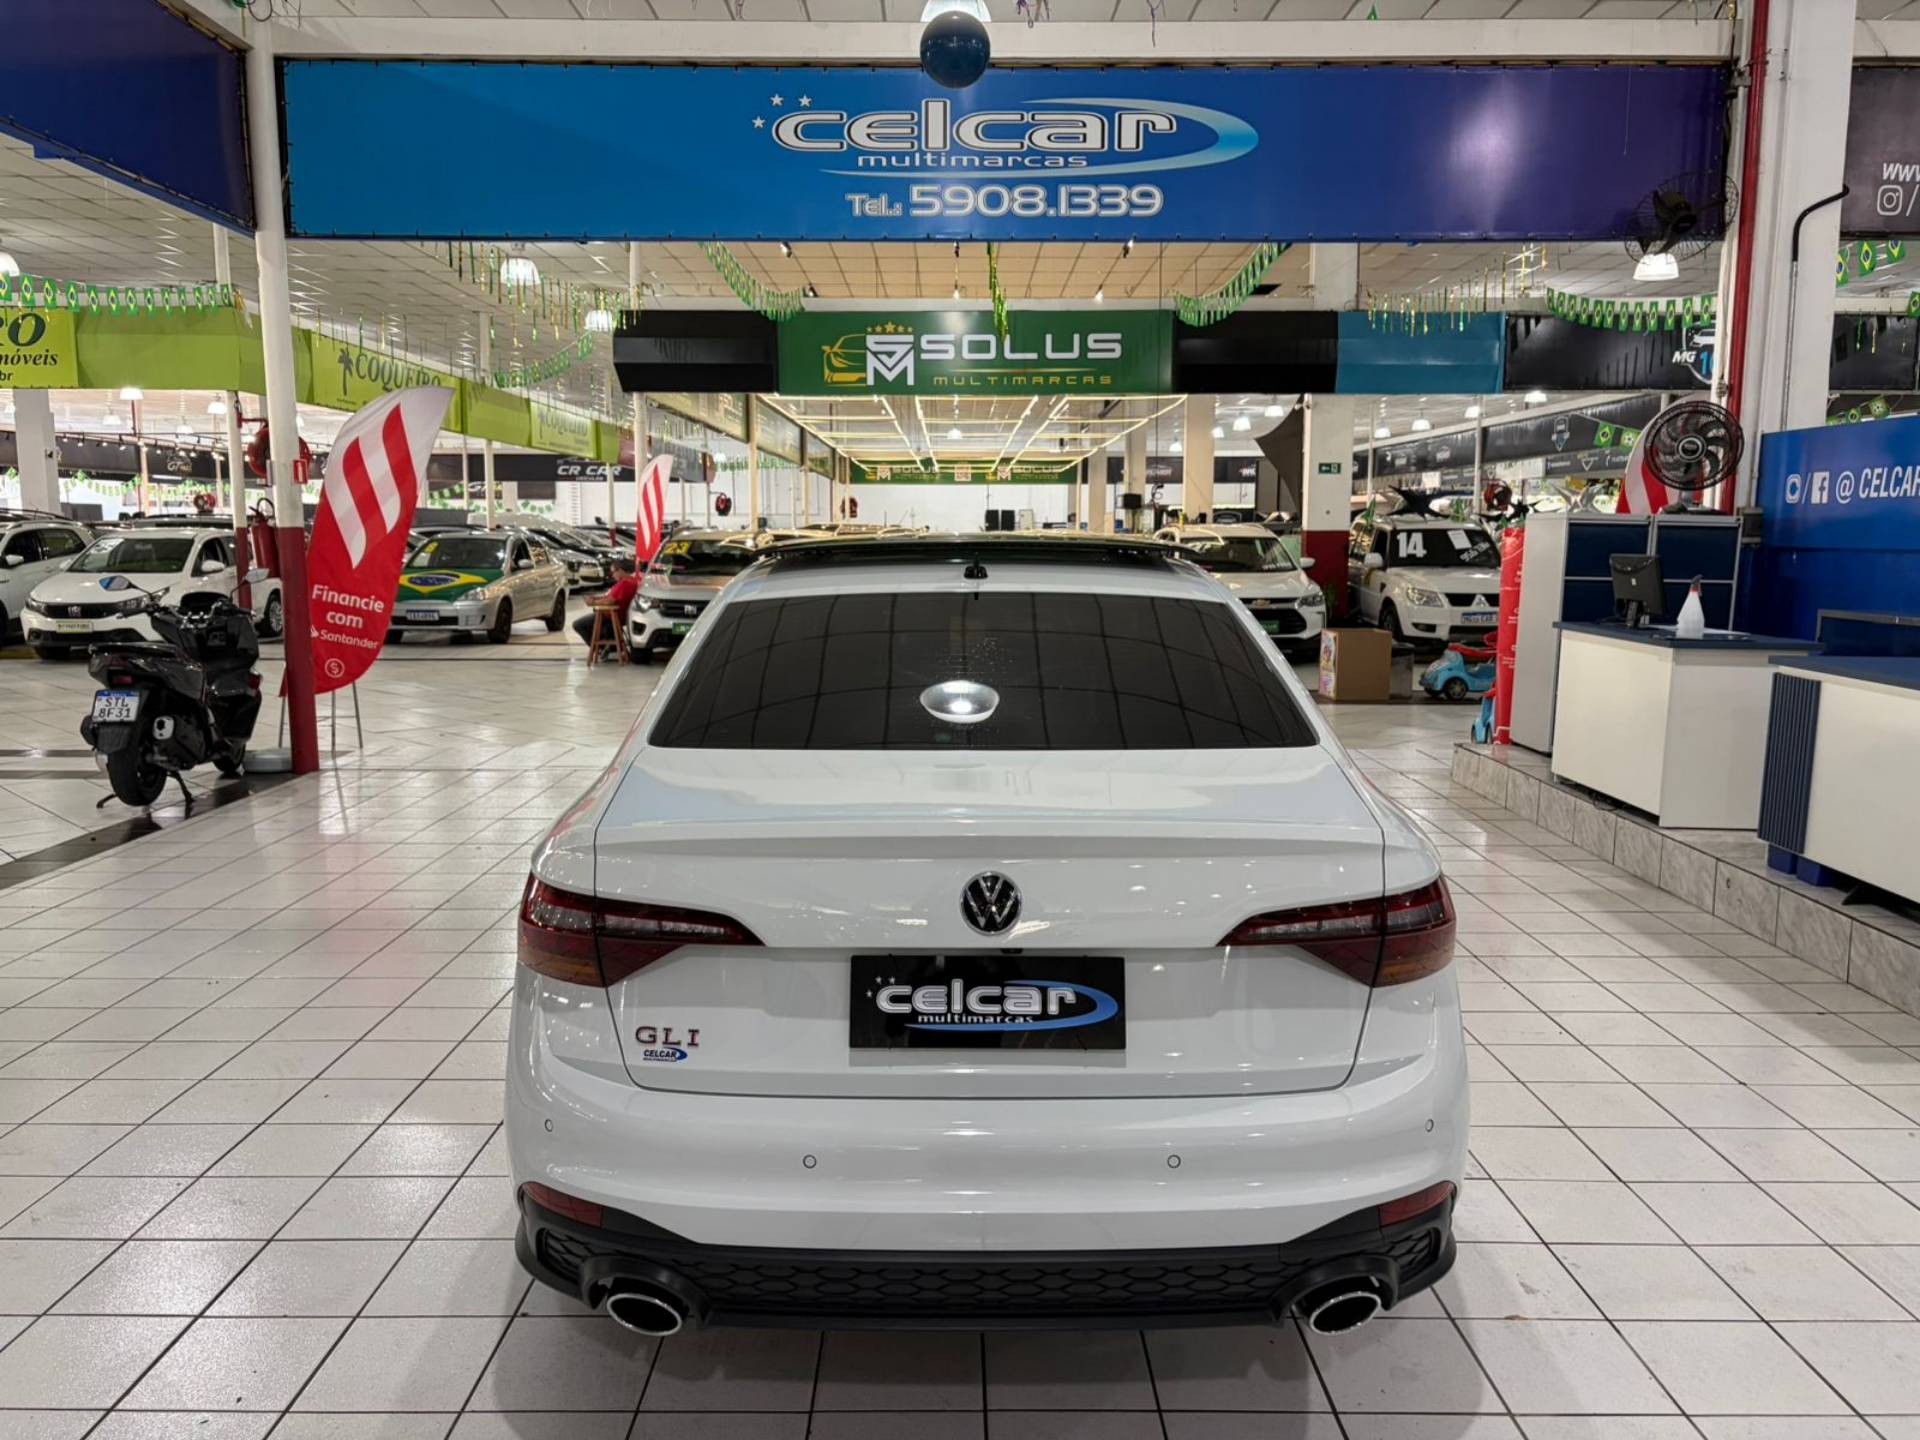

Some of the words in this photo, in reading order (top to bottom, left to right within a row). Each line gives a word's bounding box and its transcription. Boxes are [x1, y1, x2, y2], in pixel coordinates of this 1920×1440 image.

[772, 98, 1177, 152] celcar
[857, 152, 1088, 168] multimarcas
[909, 184, 1164, 217] 5908.1339
[920, 333, 1122, 360] SOLUS
[1672, 350, 1697, 363] MG
[933, 375, 1112, 385] MULTIMARCAS
[557, 465, 581, 476] CR
[1396, 532, 1427, 558] 14
[312, 583, 385, 613] Financie
[326, 611, 363, 629] com
[320, 629, 378, 649] Santander
[105, 696, 128, 707] STL
[99, 707, 130, 718] 8F31
[876, 978, 1076, 1015] celcar
[917, 1013, 1034, 1024] multimarcas
[635, 1025, 700, 1047] GLI
[643, 1049, 677, 1058] CELCAR
